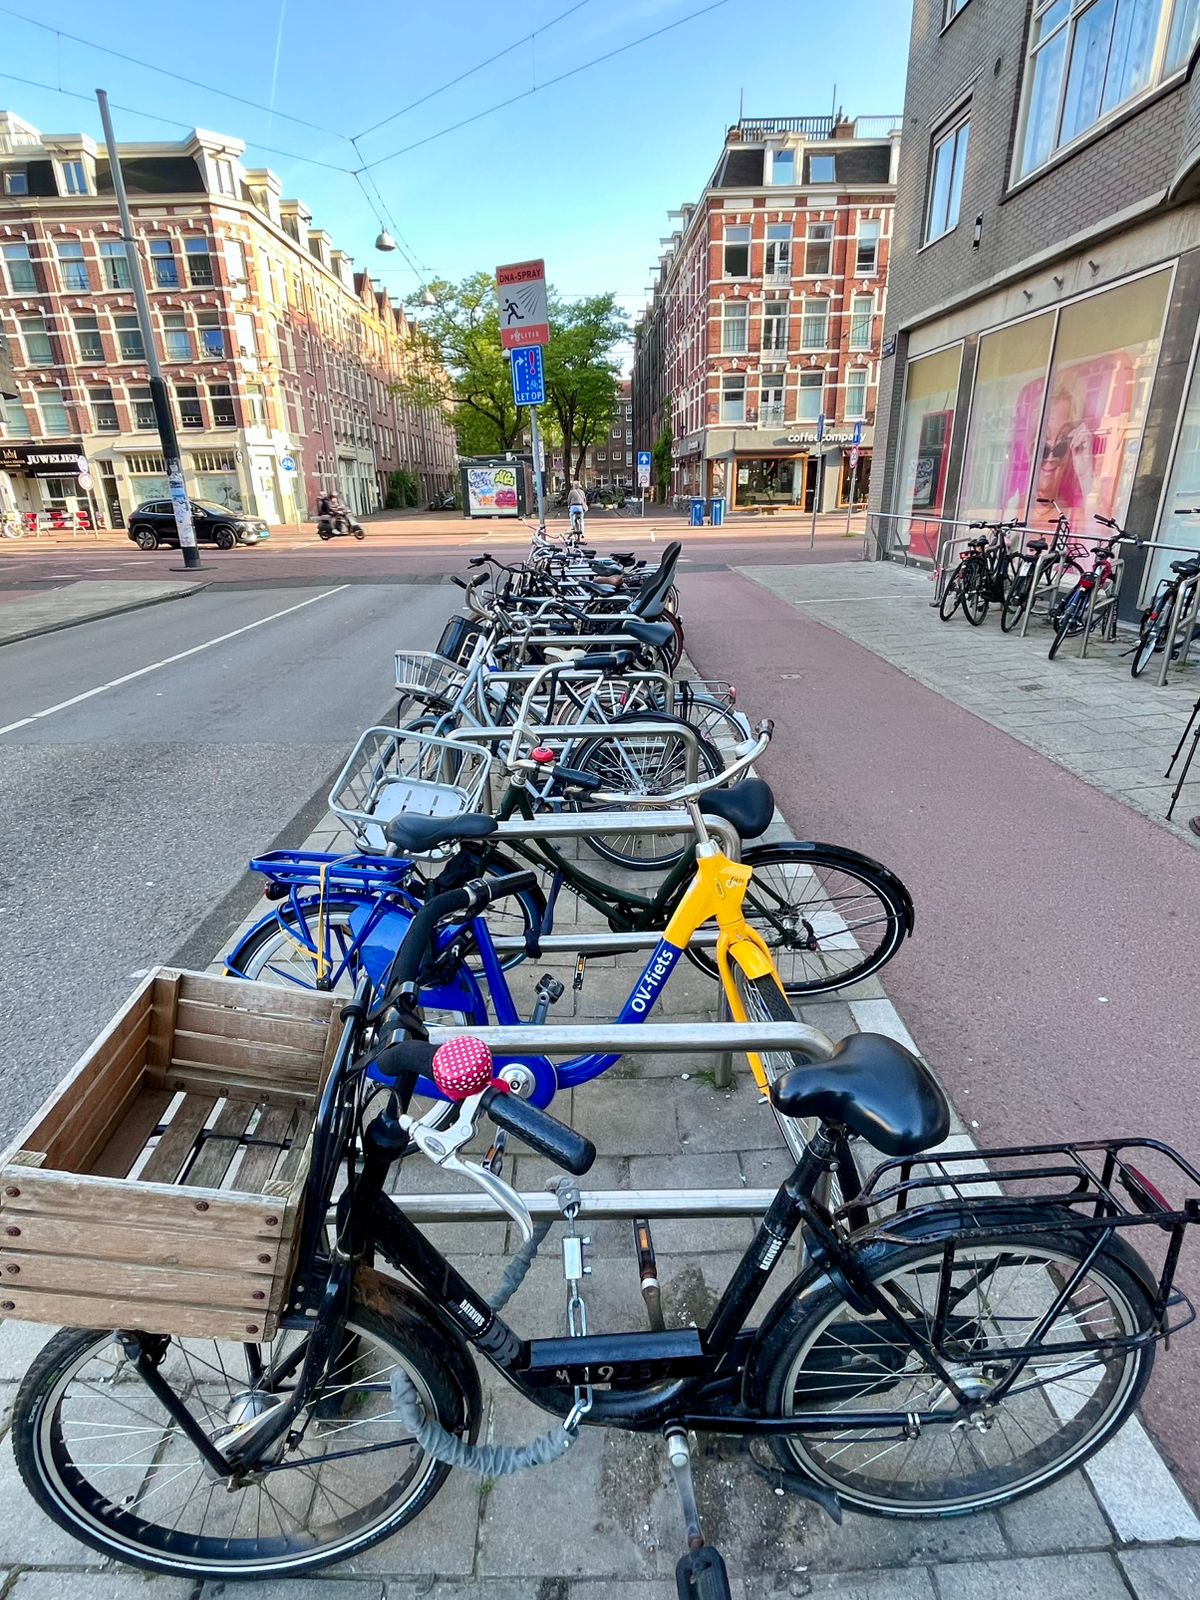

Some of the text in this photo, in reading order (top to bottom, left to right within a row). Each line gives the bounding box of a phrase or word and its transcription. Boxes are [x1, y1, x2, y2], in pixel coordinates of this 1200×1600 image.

[499, 268, 541, 283] DNA-SPRAY
[517, 391, 542, 402] LET OP
[26, 453, 80, 466] JUWELIER
[631, 949, 674, 1013] OV-fiets
[760, 1239, 783, 1271] BATAVUS
[459, 1299, 485, 1327] BATAVUS
